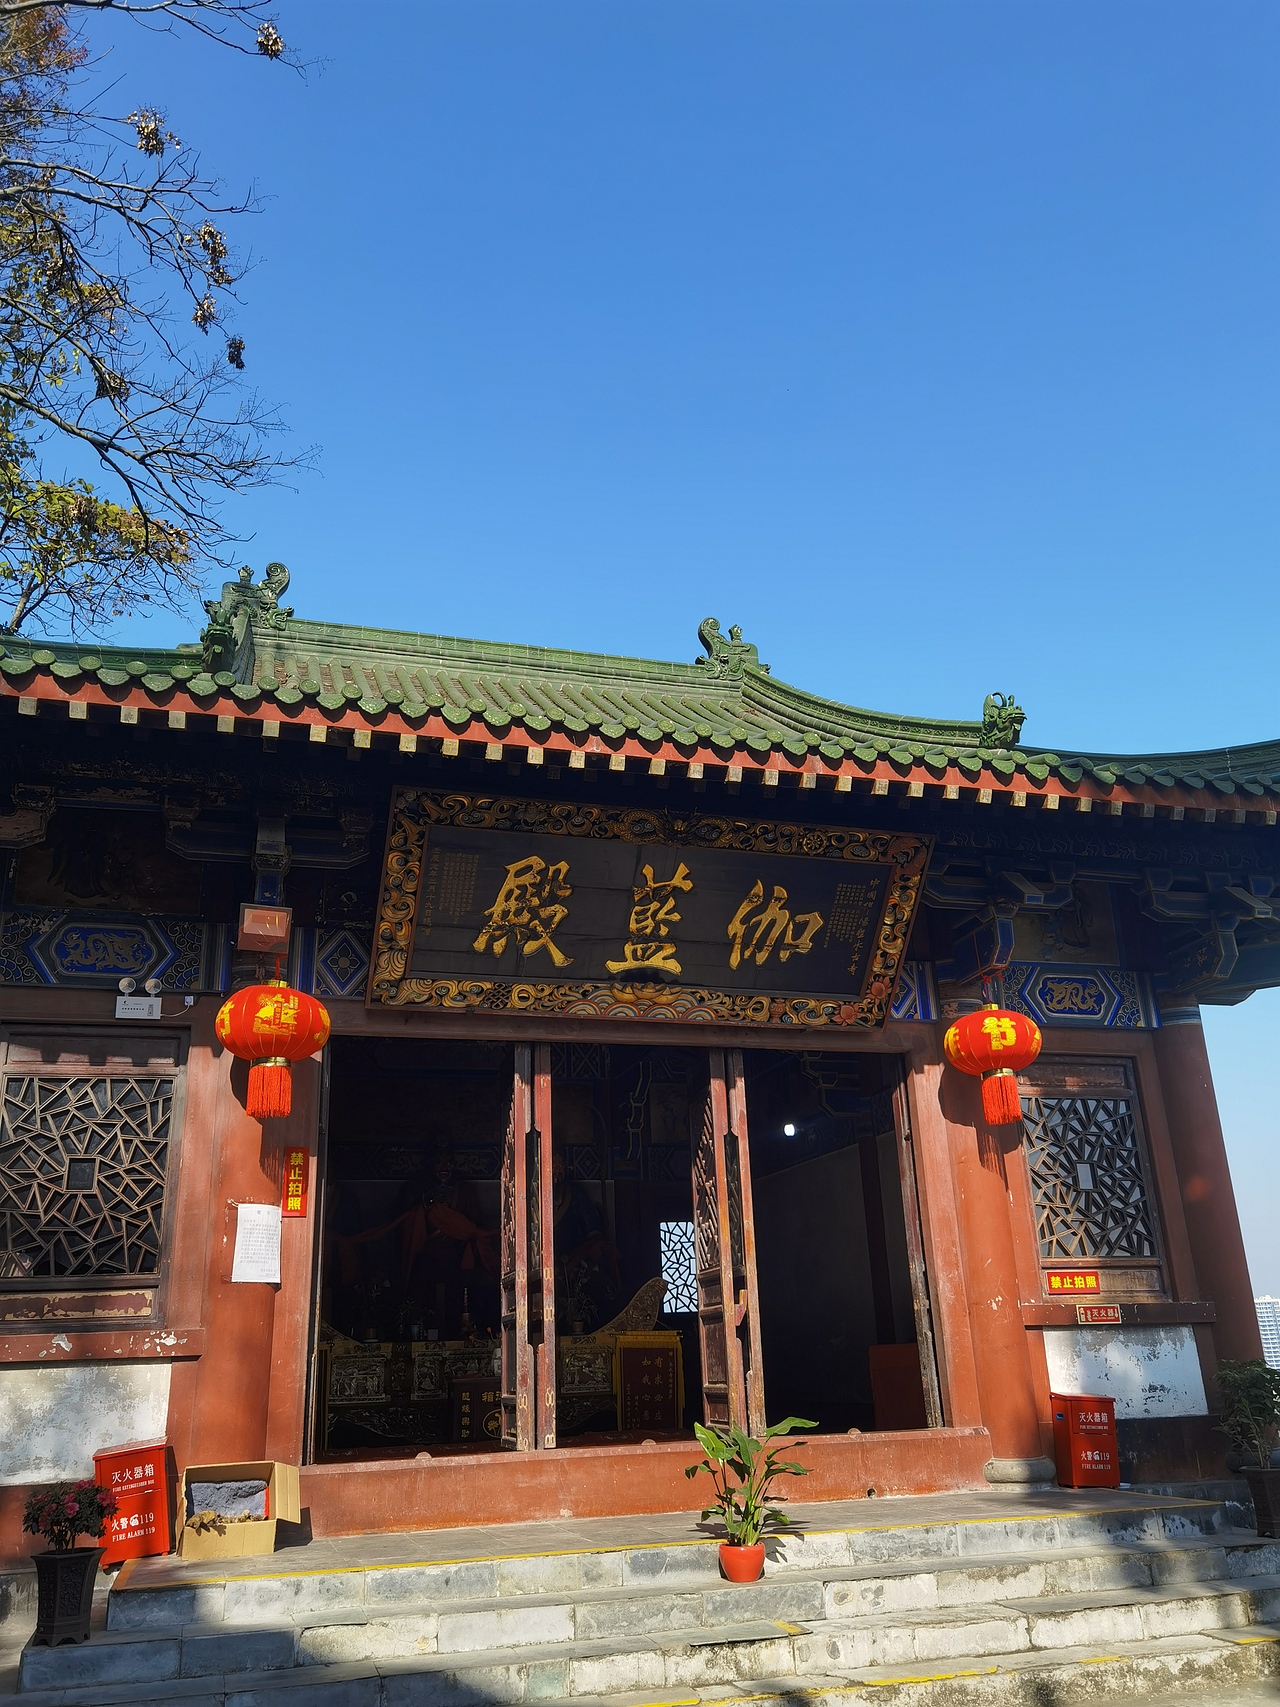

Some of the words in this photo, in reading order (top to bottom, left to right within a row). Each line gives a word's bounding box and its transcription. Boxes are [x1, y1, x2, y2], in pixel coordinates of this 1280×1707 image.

[287, 1152, 304, 1210] 禁止拍照
[1050, 1275, 1097, 1289] 禁止拍照
[1092, 1308, 1114, 1317] 灭火器
[1079, 1412, 1108, 1423] 灭火器箱
[1080, 1451, 1093, 1461] 火警
[1100, 1452, 1110, 1461] 119
[111, 1463, 154, 1485] 灭火器箱
[111, 1517, 128, 1532] 火警
[140, 1512, 154, 1525] 119
[112, 1533, 126, 1542] FIRE
[128, 1530, 144, 1538] ALARM
[146, 1526, 155, 1534] 119
